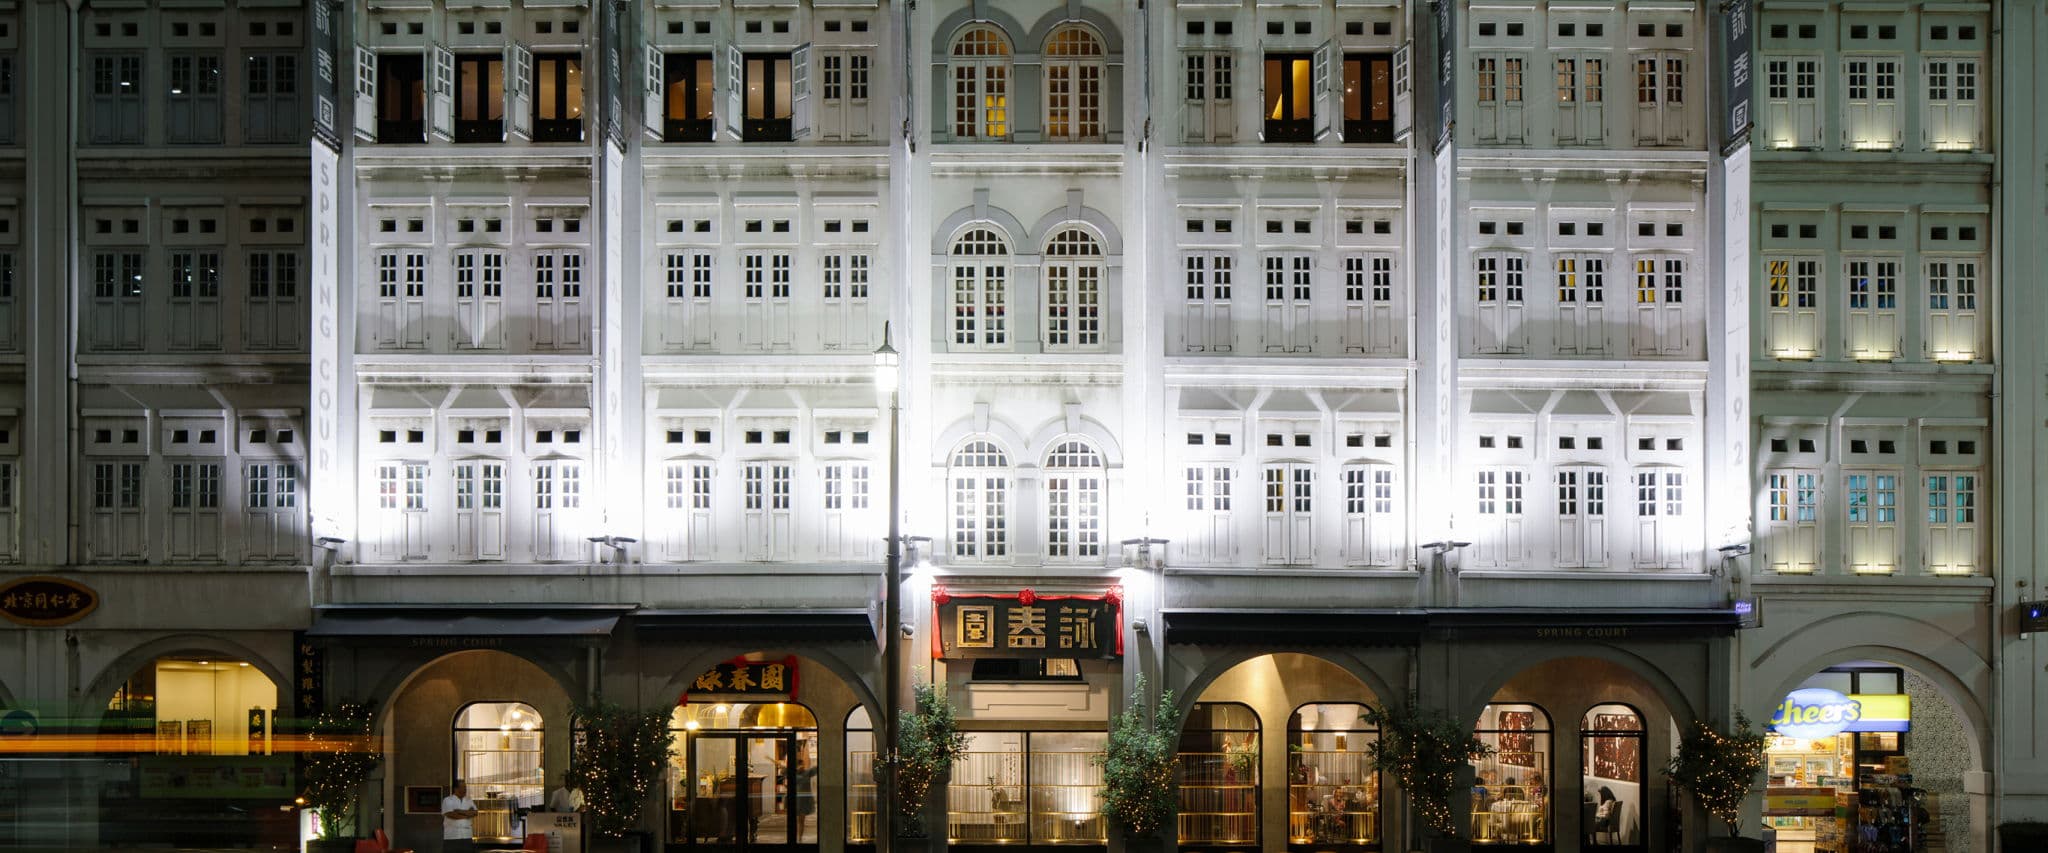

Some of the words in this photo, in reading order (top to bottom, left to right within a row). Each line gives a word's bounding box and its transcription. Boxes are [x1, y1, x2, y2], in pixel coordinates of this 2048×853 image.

[319, 163, 331, 339] SPRING
[320, 358, 331, 471] COUR
[1733, 353, 1744, 467] 192
[411, 637, 457, 648] SPRING
[463, 637, 504, 648] COURT
[1536, 628, 1582, 637] SPRING
[1587, 628, 1629, 637] COURT
